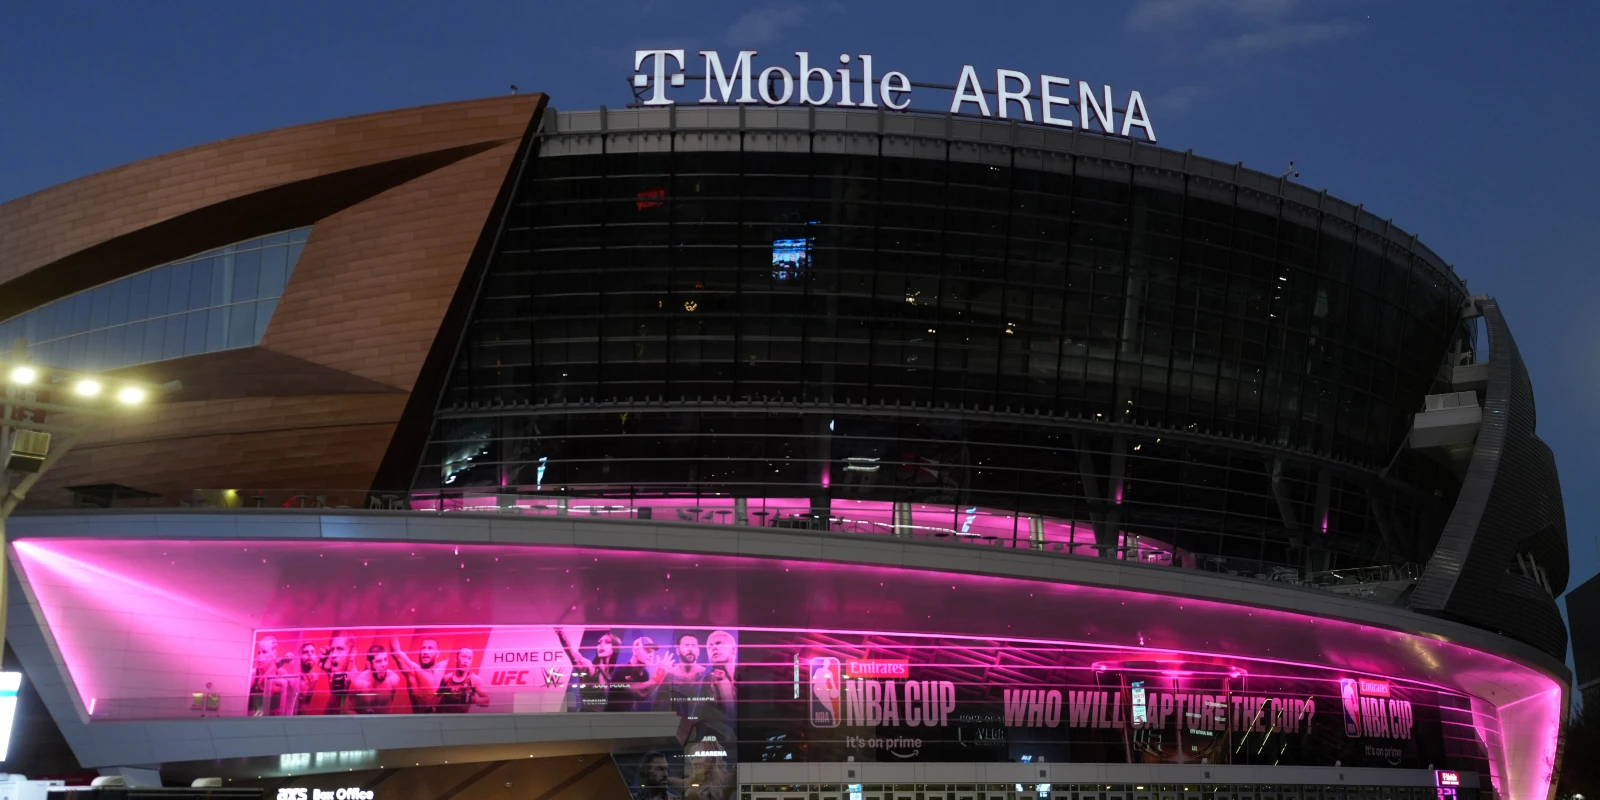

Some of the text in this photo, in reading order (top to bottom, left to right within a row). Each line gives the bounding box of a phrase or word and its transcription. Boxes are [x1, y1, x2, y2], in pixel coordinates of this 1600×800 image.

[950, 64, 1157, 142] ARENA
[494, 651, 564, 662] HOME OF
[850, 661, 905, 674] Emirates
[491, 671, 529, 685] UFC
[1361, 681, 1388, 693] Emirates
[846, 680, 956, 727] NBA CUP
[815, 712, 829, 722] NBA
[1003, 689, 1062, 728] WHO
[1068, 690, 1124, 729] WILL
[1230, 695, 1266, 732] THE
[1270, 697, 1315, 734] CUP?
[1360, 697, 1413, 739] NBA CUP
[846, 736, 922, 750] It's on prime
[313, 788, 334, 800] Box
[336, 787, 374, 800] Office
